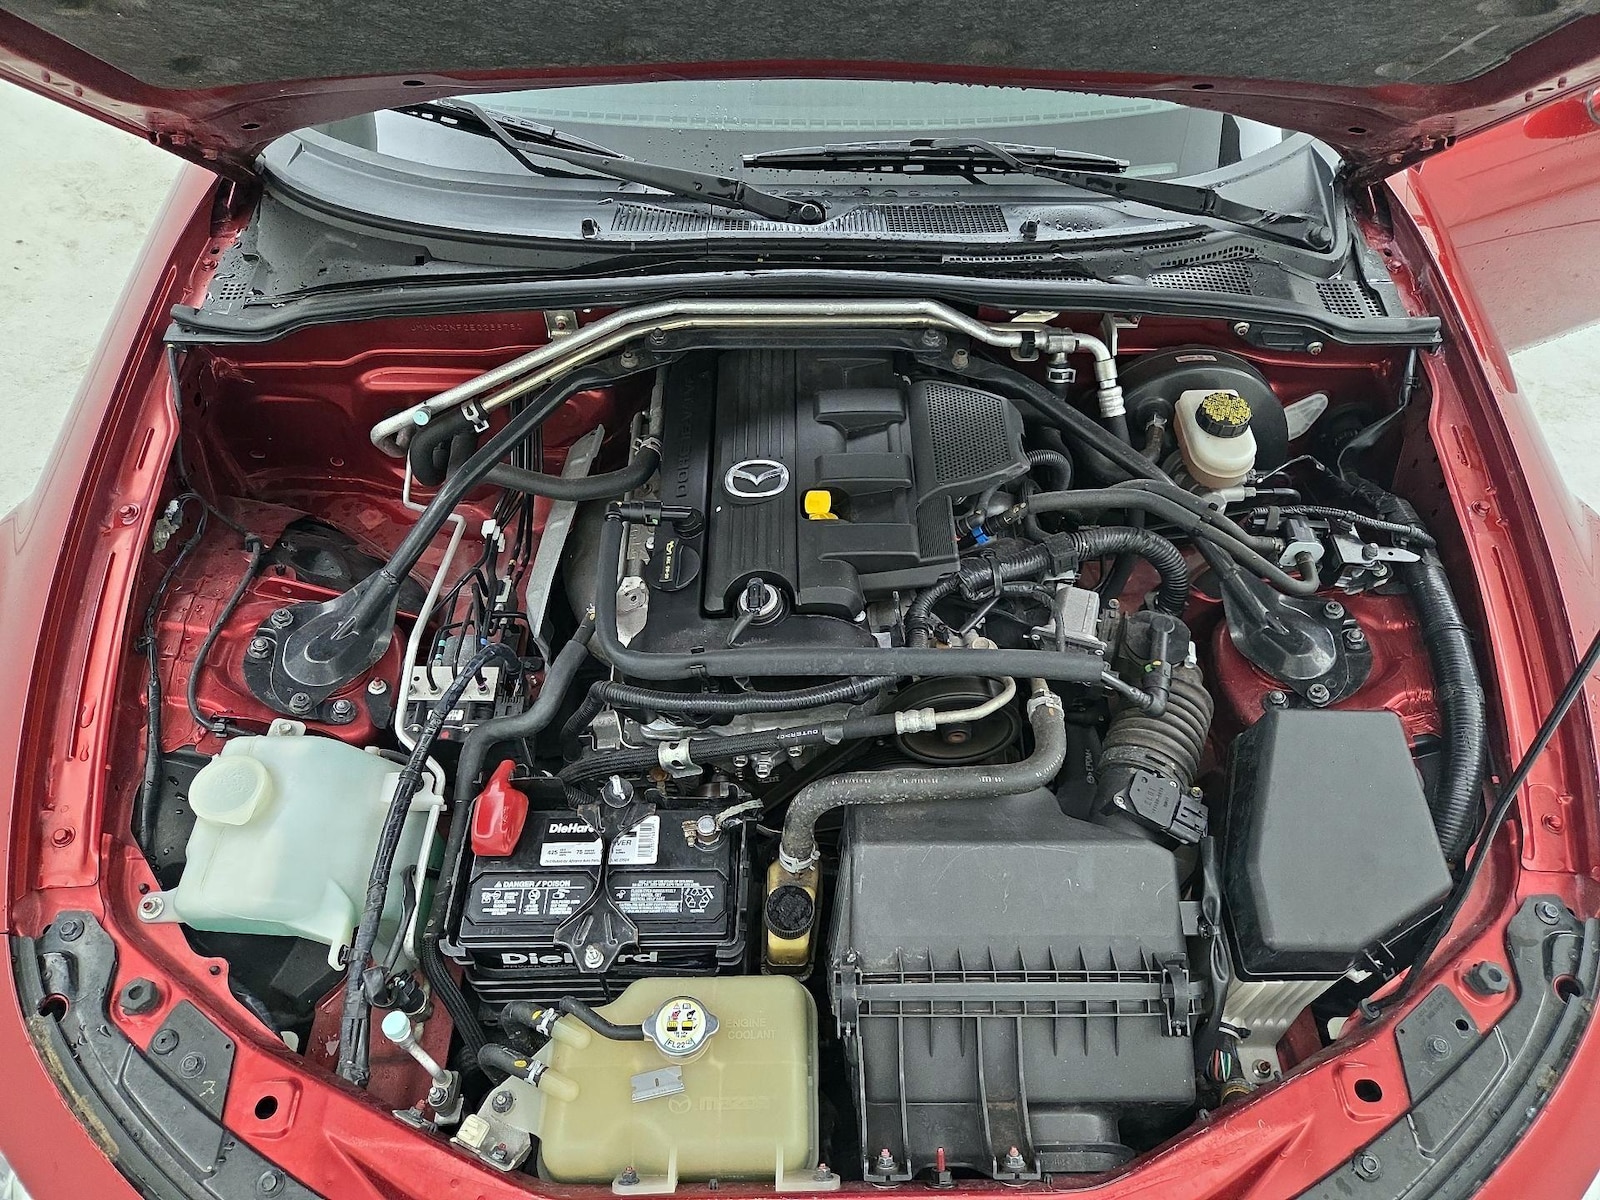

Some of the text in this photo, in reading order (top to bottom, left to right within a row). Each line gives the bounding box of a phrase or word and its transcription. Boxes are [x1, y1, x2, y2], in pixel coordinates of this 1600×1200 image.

[503, 880, 535, 888] DANGER
[725, 1018, 767, 1028] ENGINE
[727, 1029, 777, 1040] COOLANT
